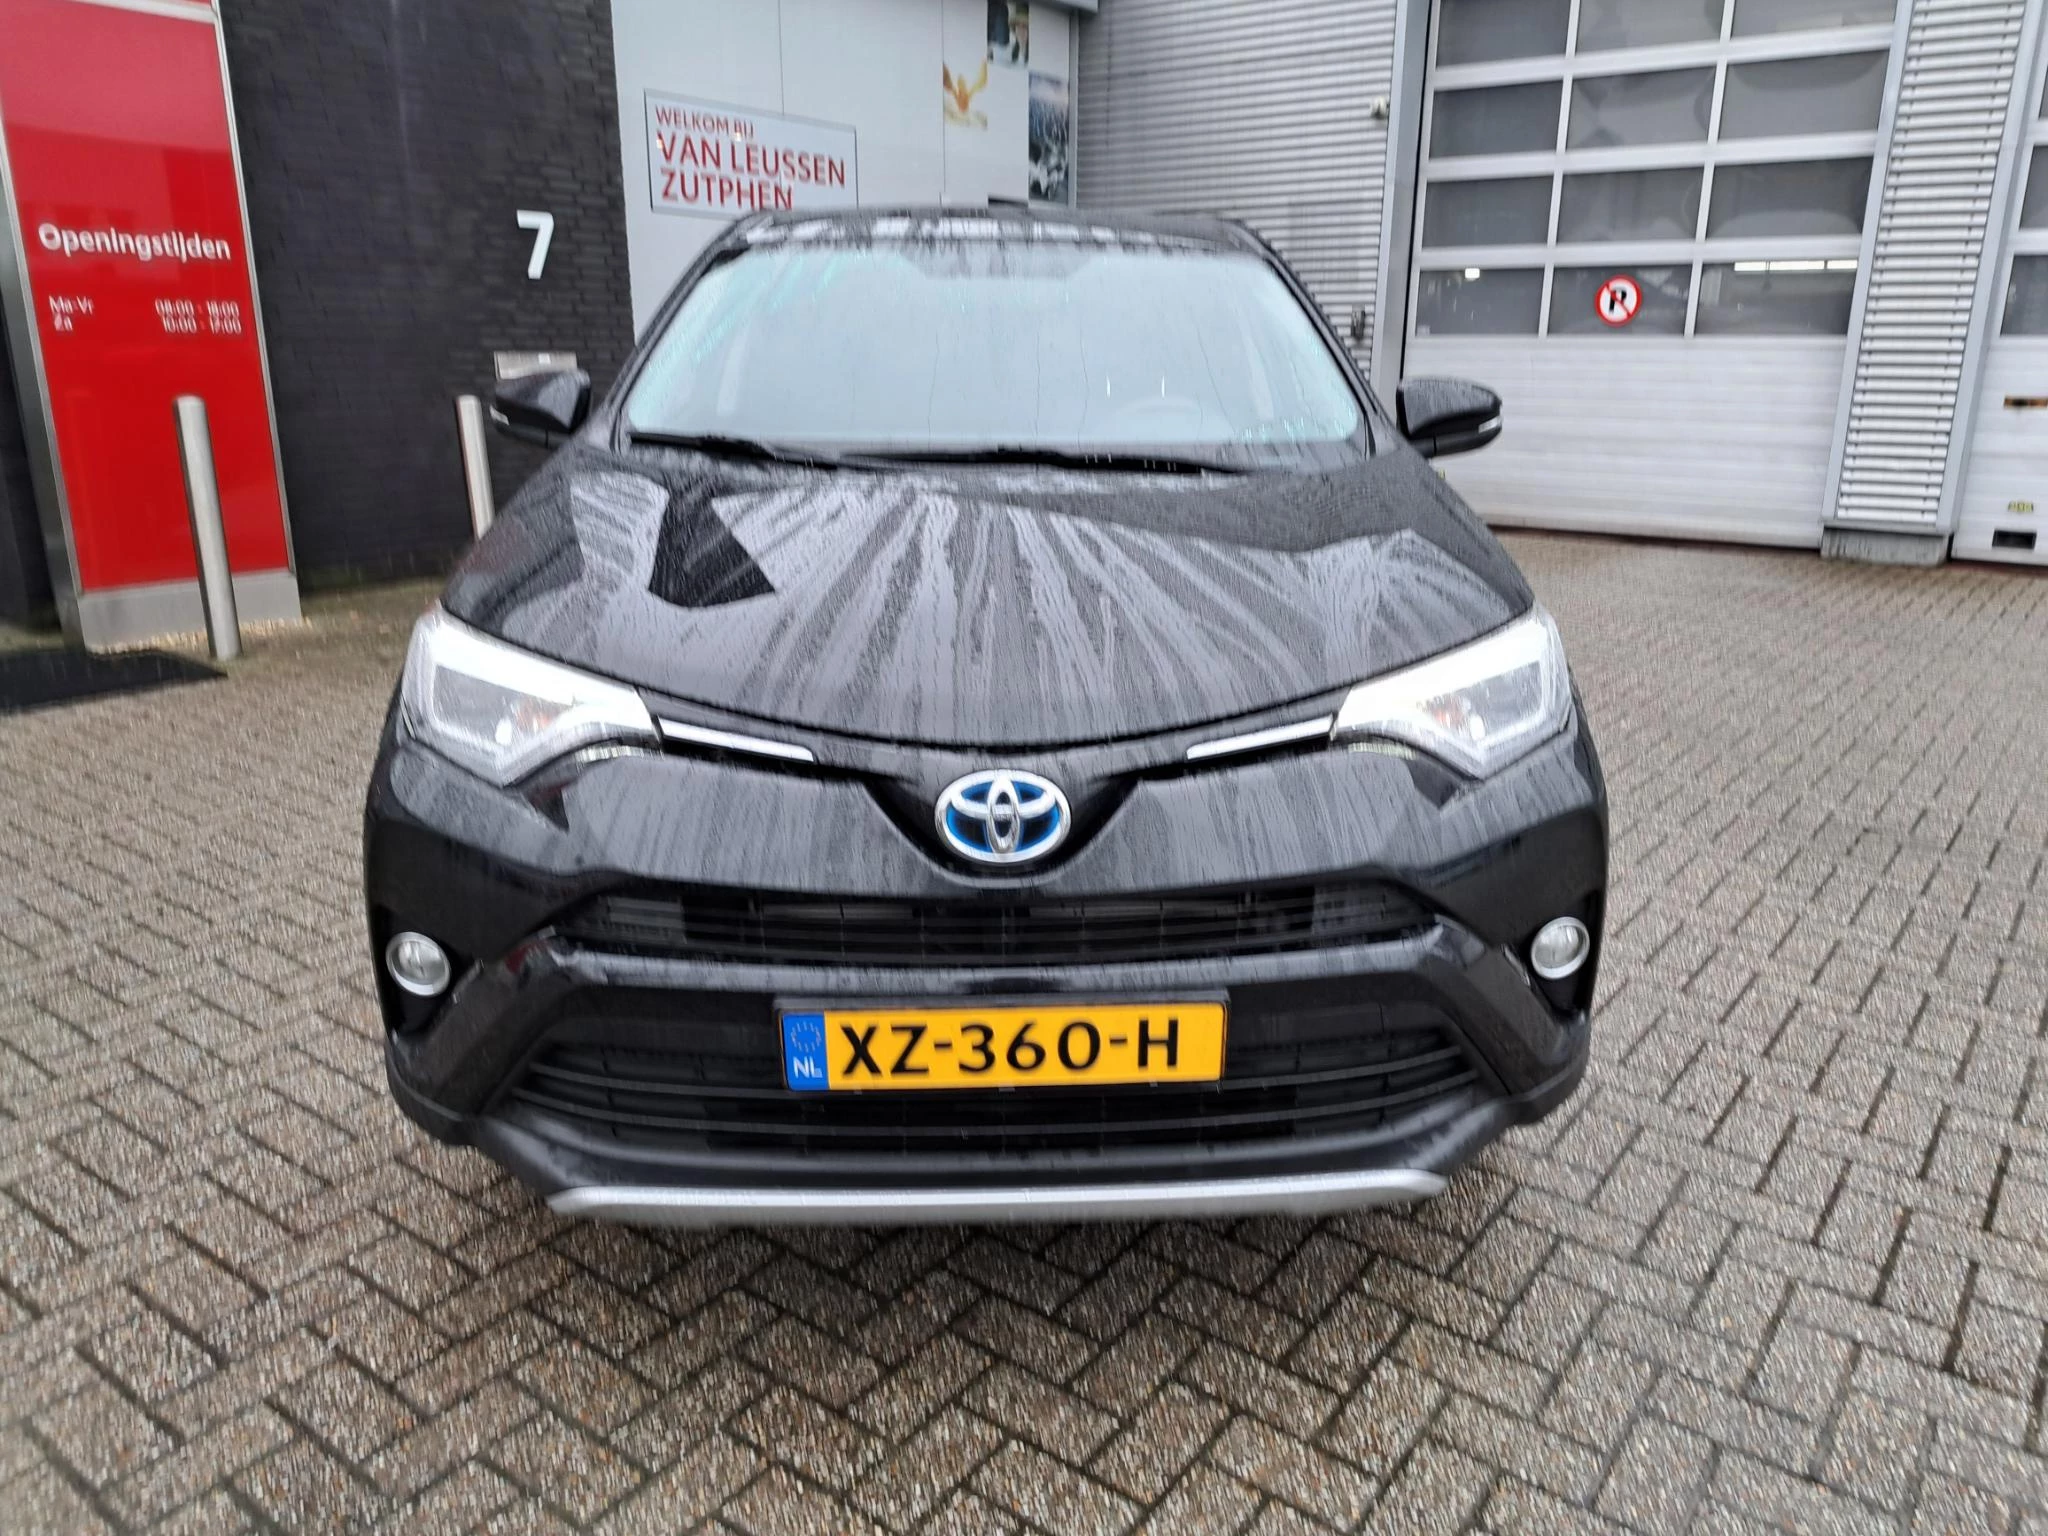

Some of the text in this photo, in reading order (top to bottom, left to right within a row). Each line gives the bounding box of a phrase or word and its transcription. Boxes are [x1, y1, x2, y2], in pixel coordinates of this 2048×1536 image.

[655, 104, 729, 135] WELKOM
[656, 130, 845, 189] VAN LEUSSEN
[660, 166, 793, 212] ZUTPHEN
[38, 222, 231, 264] Openingstijden
[517, 209, 555, 280] 7
[792, 1055, 823, 1079] NL
[841, 1017, 1180, 1077] XZ-360-H
